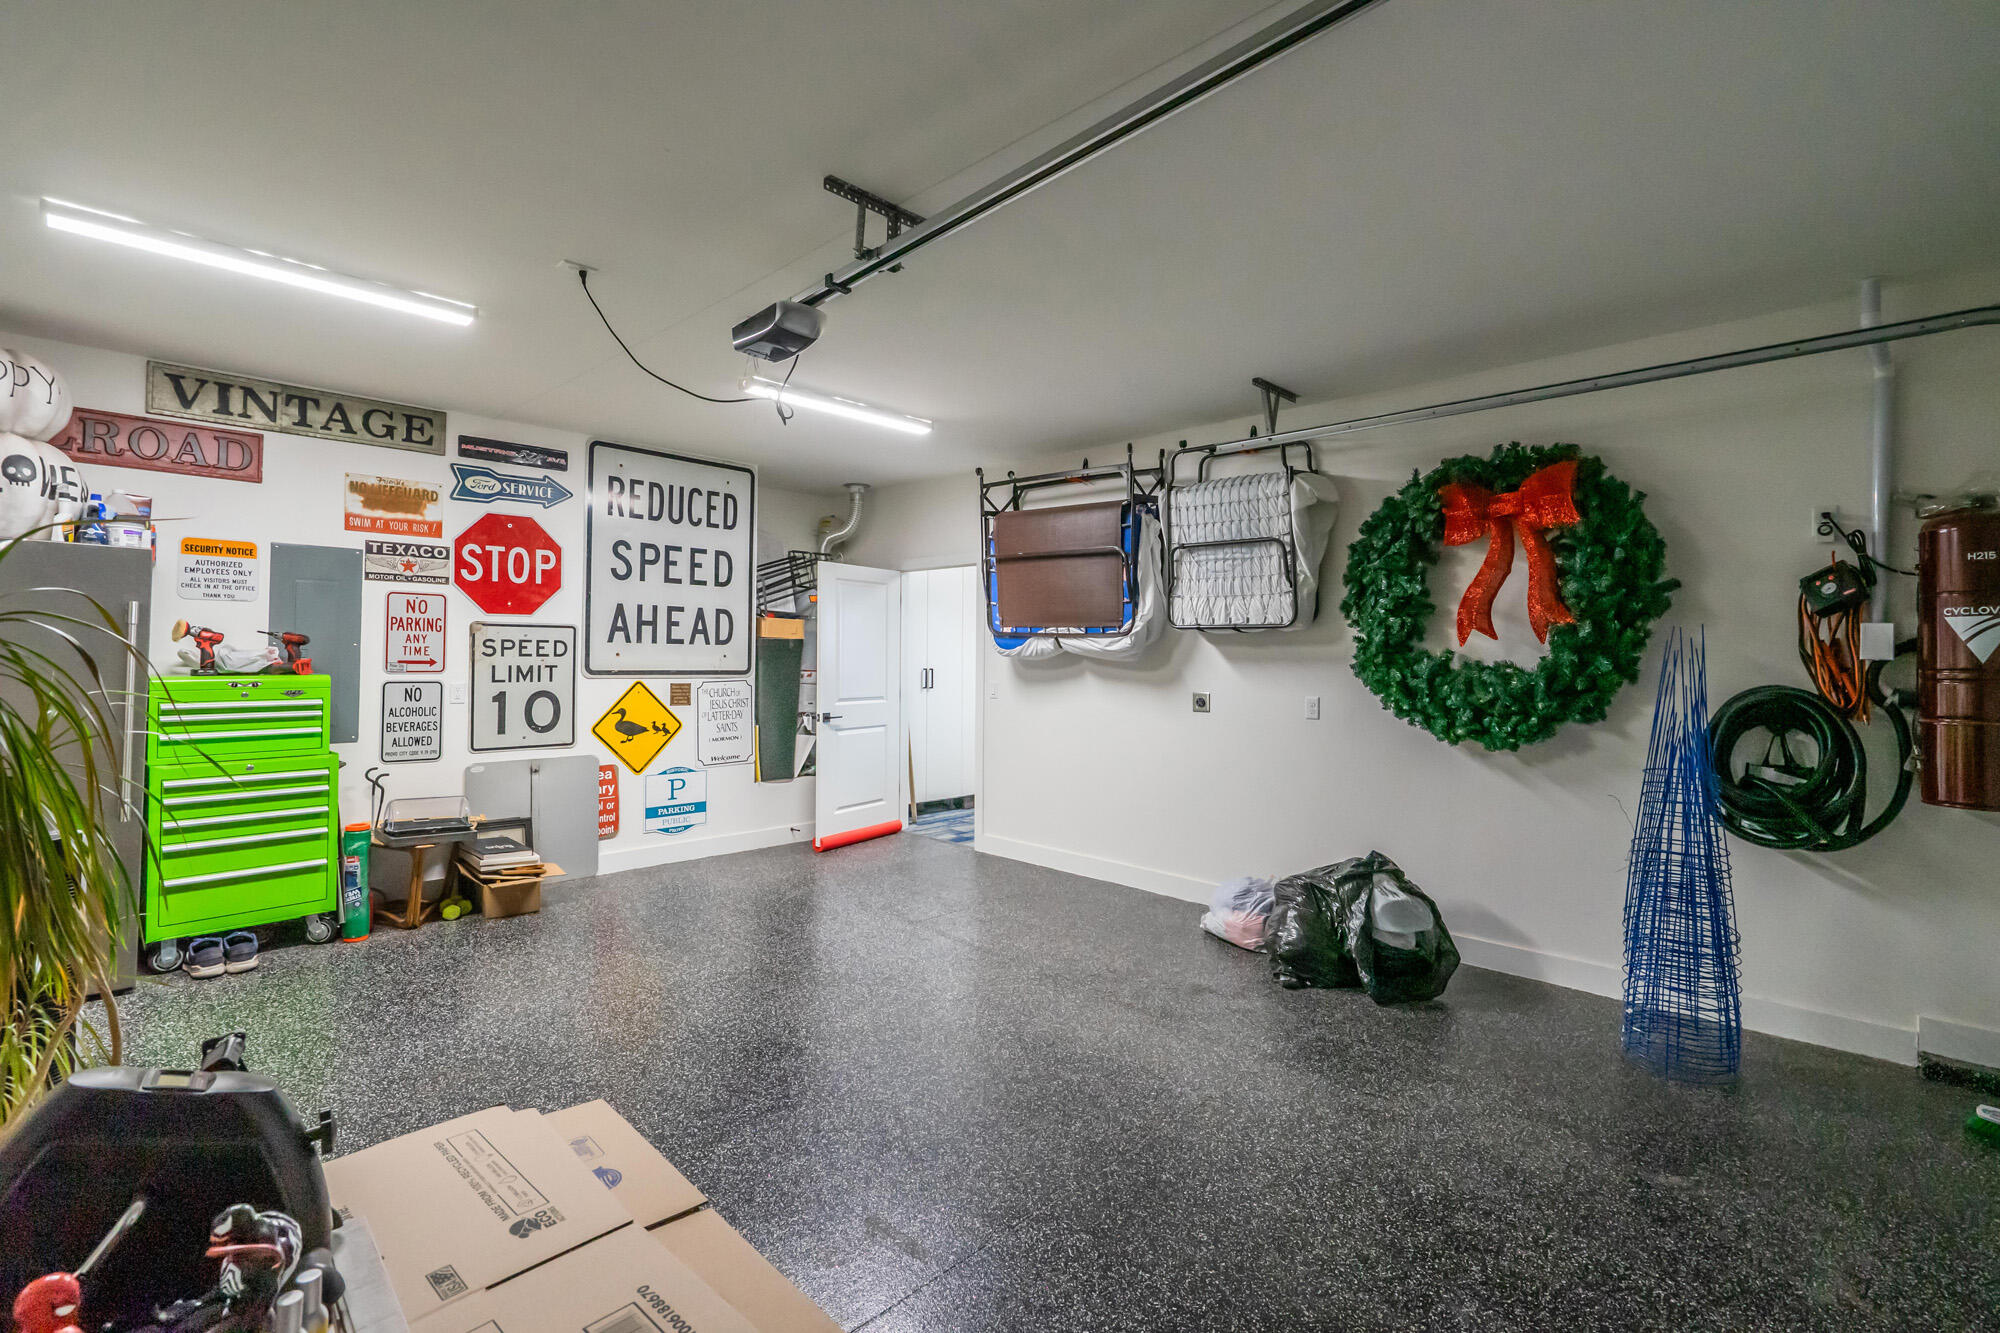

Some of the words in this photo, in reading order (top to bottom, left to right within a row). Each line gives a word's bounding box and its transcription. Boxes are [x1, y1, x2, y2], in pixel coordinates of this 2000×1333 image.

[164, 372, 434, 446] VINTAGE
[470, 478, 496, 491] Ford
[502, 481, 554, 499] SERVICE
[607, 475, 738, 530] REDUCED
[349, 517, 371, 528] SWIM
[375, 519, 384, 529] AT
[389, 521, 408, 532] YOUR
[413, 523, 428, 533] RISK
[184, 543, 224, 554] SECURITY
[226, 547, 254, 556] NOTICE
[368, 541, 447, 559] TEXACO
[1967, 551, 1997, 560] H215
[195, 559, 243, 568] AUTHORIZED
[460, 543, 557, 585] STOP
[610, 539, 733, 587] SPEED
[184, 567, 230, 576] EMPLOYEES
[232, 569, 252, 577] ONLY
[412, 576, 447, 584] GASOLINE
[406, 599, 428, 615] NO
[390, 616, 442, 633] PARKING
[607, 603, 734, 645] AHEAD
[405, 633, 428, 644] ANY
[402, 646, 430, 656] TIME
[481, 638, 568, 657] SPEED
[491, 664, 558, 683] LIMIT
[404, 687, 422, 702] NO
[709, 687, 735, 698] CHURCH
[710, 699, 728, 710] JESUS
[728, 698, 749, 709] CHRIST
[388, 706, 437, 718] ALCOHOLIC
[491, 690, 561, 735] 10
[707, 710, 743, 721] LATTER-DAY
[386, 721, 438, 733] BEVERAGES
[716, 722, 738, 733] SAINTS
[391, 736, 433, 747] ALLOWED
[710, 754, 740, 762] Welcome
[667, 778, 686, 800] P
[657, 804, 695, 816] PARKING
[662, 816, 691, 826] PUBLIC
[444, 1153, 472, 1179] RECYCLED
[476, 1189, 497, 1207] FROM
[490, 1204, 511, 1222] MADE
[534, 1210, 557, 1228] ECO
